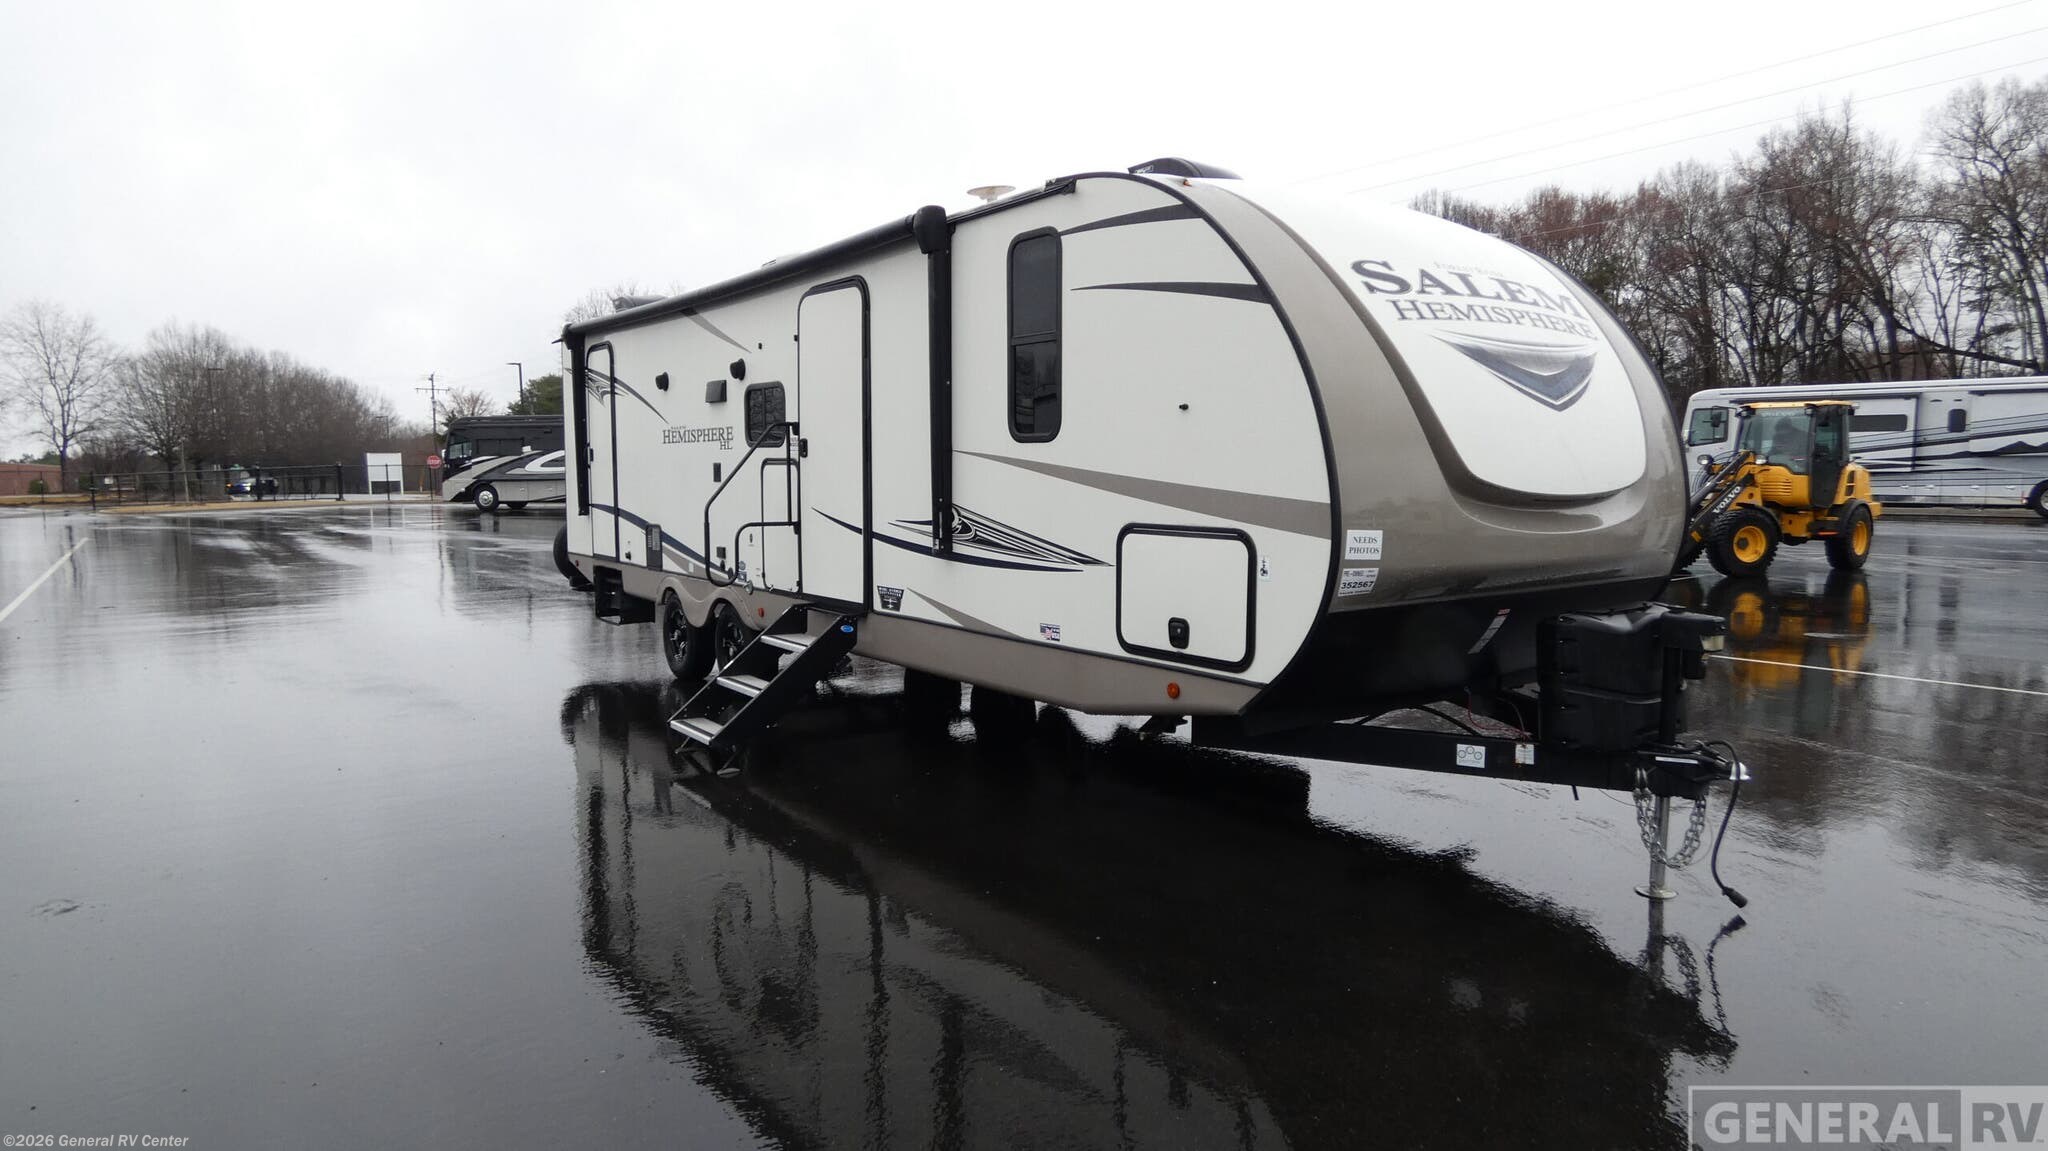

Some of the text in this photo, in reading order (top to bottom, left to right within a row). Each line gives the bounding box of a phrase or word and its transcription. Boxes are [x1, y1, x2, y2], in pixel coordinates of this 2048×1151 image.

[1351, 260, 1585, 317] SALEM
[1386, 300, 1598, 340] HEMISPHERE
[663, 427, 733, 443] HEMISPHERE
[720, 440, 733, 450] HL
[1713, 486, 1741, 513] VOLVO
[1353, 536, 1378, 544] NEEDS
[1349, 546, 1380, 554] PHOTOS
[1341, 581, 1374, 589] 352567
